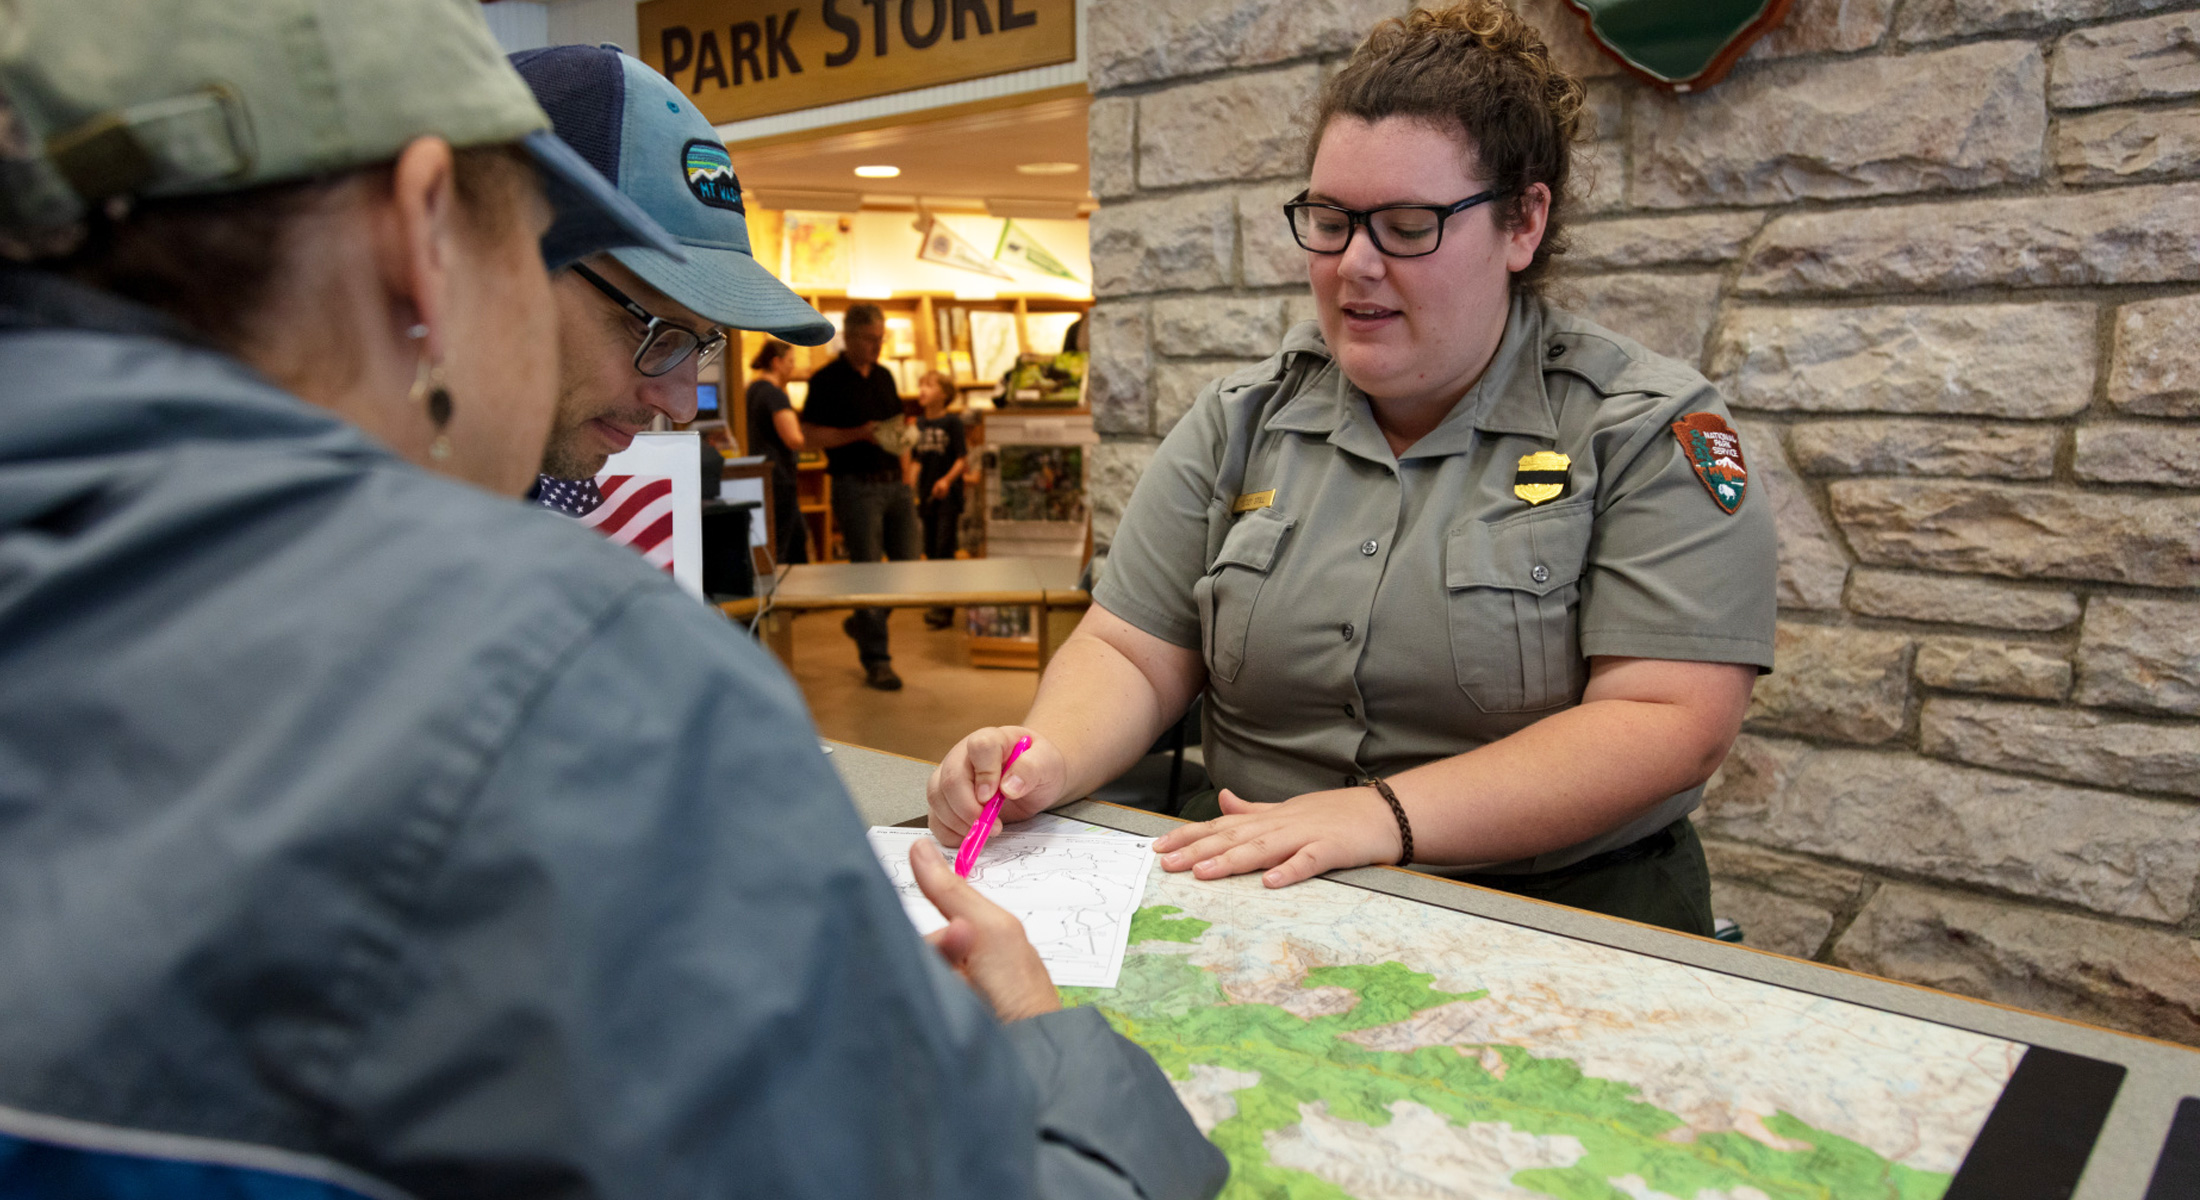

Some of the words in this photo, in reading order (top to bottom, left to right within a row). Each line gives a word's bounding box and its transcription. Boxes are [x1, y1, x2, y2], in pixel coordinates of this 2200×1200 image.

[661, 8, 803, 95] PARK
[700, 181, 716, 198] MT
[1702, 430, 1737, 444] NATIONAL
[1713, 439, 1732, 448] PARK
[1711, 446, 1739, 458] SERVICE
